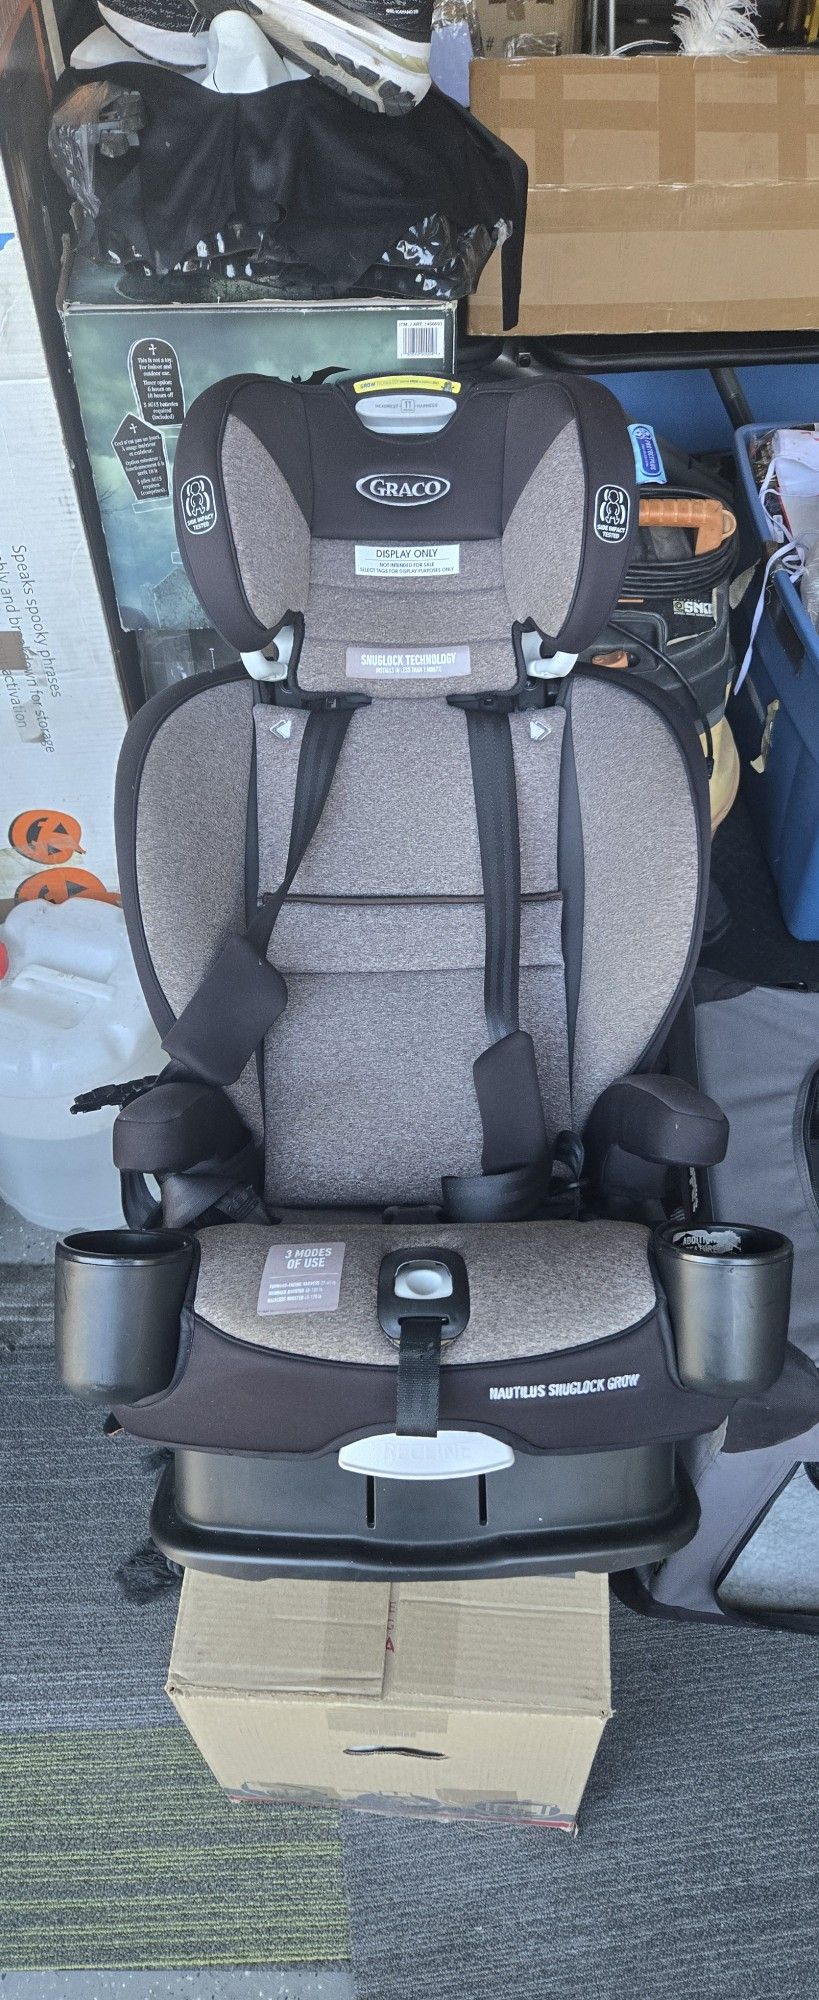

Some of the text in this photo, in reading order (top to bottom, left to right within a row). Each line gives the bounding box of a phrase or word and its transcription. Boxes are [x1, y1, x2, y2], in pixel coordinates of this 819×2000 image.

[370, 479, 440, 497] GRACO
[193, 521, 210, 530] TESTED
[197, 513, 214, 522] IMPACT
[602, 531, 620, 539] TESTED
[376, 549, 438, 558] DISPLAY ONLY
[1, 588, 20, 612] and
[11, 545, 61, 698] Speaks spooky phrases
[361, 652, 456, 666] SNUGLOCK TECHNOLOGY
[2, 669, 27, 728] activation
[30, 688, 43, 707] for
[34, 709, 55, 753] storage
[285, 1248, 332, 1259] 3 MODES
[287, 1257, 325, 1269] OF USE
[489, 1374, 640, 1400] NAUTILUS SNUGLOCK GROW
